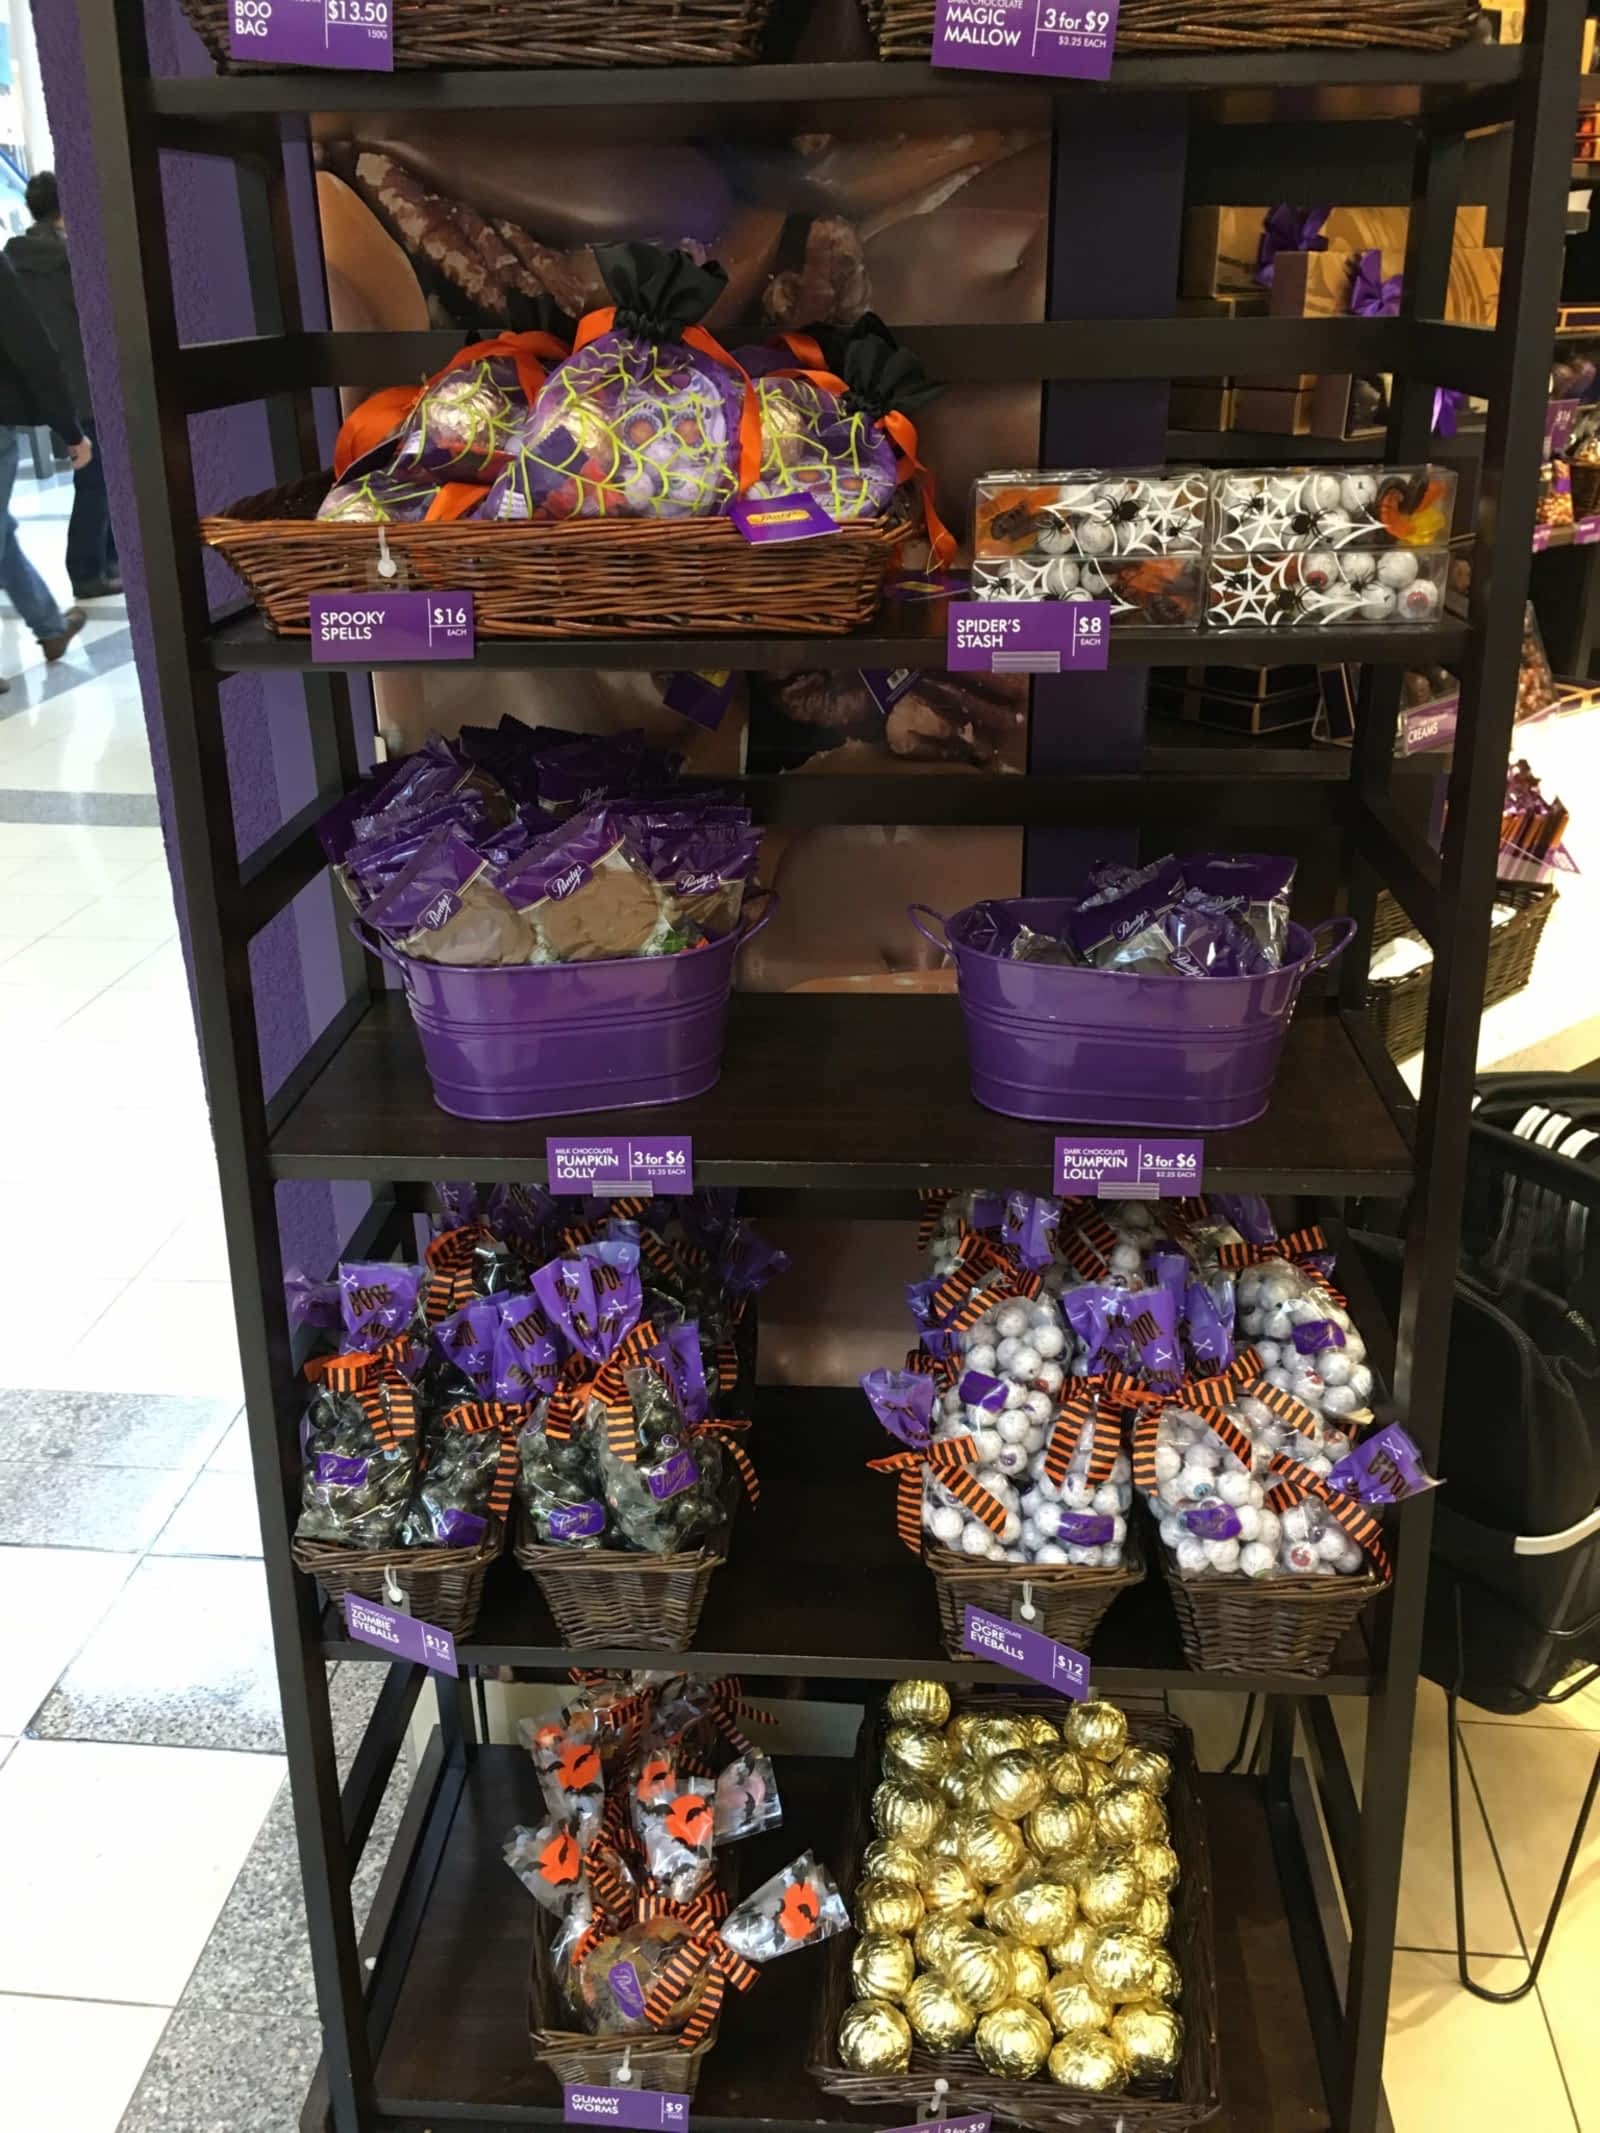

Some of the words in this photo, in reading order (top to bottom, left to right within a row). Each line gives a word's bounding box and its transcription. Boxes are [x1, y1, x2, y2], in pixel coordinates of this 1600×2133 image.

[234, 1, 272, 18] BOO
[328, 2, 387, 22] $13.50
[946, 6, 1006, 26] MAGIC
[235, 19, 269, 37] BAG
[1044, 8, 1057, 28] 3
[1059, 12, 1081, 30] for
[1084, 10, 1110, 33] $9
[944, 26, 1021, 47] MALLOW
[1084, 37, 1106, 48] EACH
[320, 611, 386, 626] SPOOKY
[434, 607, 466, 625] $16
[447, 628, 467, 637] EACH
[956, 619, 1021, 634] SPIDER'S
[1079, 617, 1102, 634] $8
[321, 626, 372, 641] SPELLS
[956, 634, 1004, 649] STASH
[1080, 638, 1101, 647] EACH
[1407, 721, 1438, 744] CREAMS
[572, 1147, 613, 1155] CHOCOLATE
[633, 1151, 644, 1166] 3
[646, 1153, 663, 1165] for
[665, 1150, 686, 1166] $6
[1063, 1147, 1081, 1156] DARK
[1083, 1147, 1125, 1156] CHOCOLATE
[556, 1154, 619, 1167] PUMPKIN
[1064, 1155, 1128, 1168] PUMPKIN
[1143, 1153, 1154, 1168] 3
[1155, 1155, 1174, 1168] for
[1176, 1153, 1197, 1168] $6
[557, 1167, 597, 1179] LOLLY
[1063, 1168, 1105, 1180] LOLLY
[1177, 1171, 1197, 1179] EACH
[351, 1608, 393, 1632] ZOMBIE
[352, 1618, 400, 1644] EYEBALLS
[971, 1621, 1006, 1642] OGRE
[426, 1634, 450, 1651] $12
[970, 1630, 1025, 1660] EYEBALLS
[1057, 1655, 1083, 1675] $12
[571, 2094, 620, 2106] GUMMY
[665, 2102, 684, 2113] $9
[572, 2102, 619, 2115] WORMS
